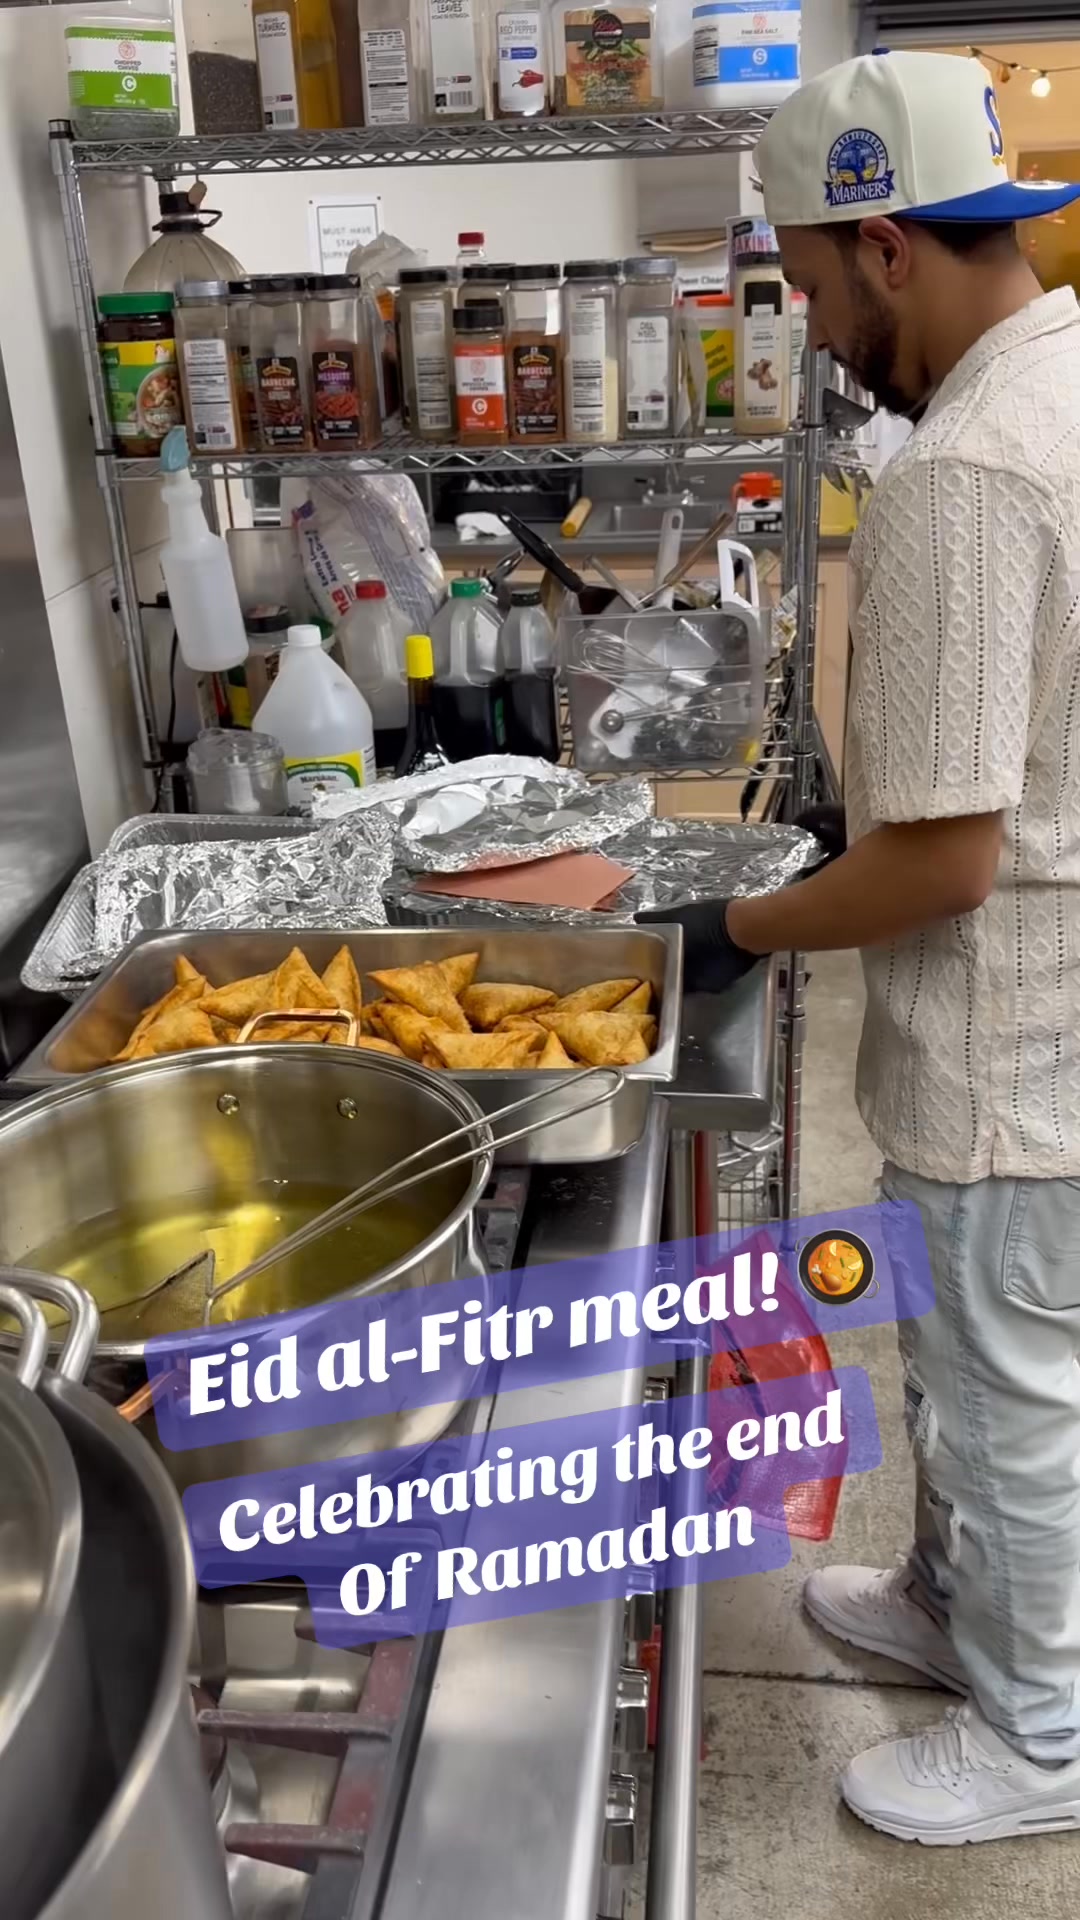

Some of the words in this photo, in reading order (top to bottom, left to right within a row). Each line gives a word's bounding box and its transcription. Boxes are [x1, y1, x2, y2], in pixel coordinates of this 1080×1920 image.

[258, 22, 286, 32] TURMERIC
[514, 25, 538, 34] PEPPER
[832, 181, 888, 204] MARINERS
[323, 227, 346, 236] MUST
